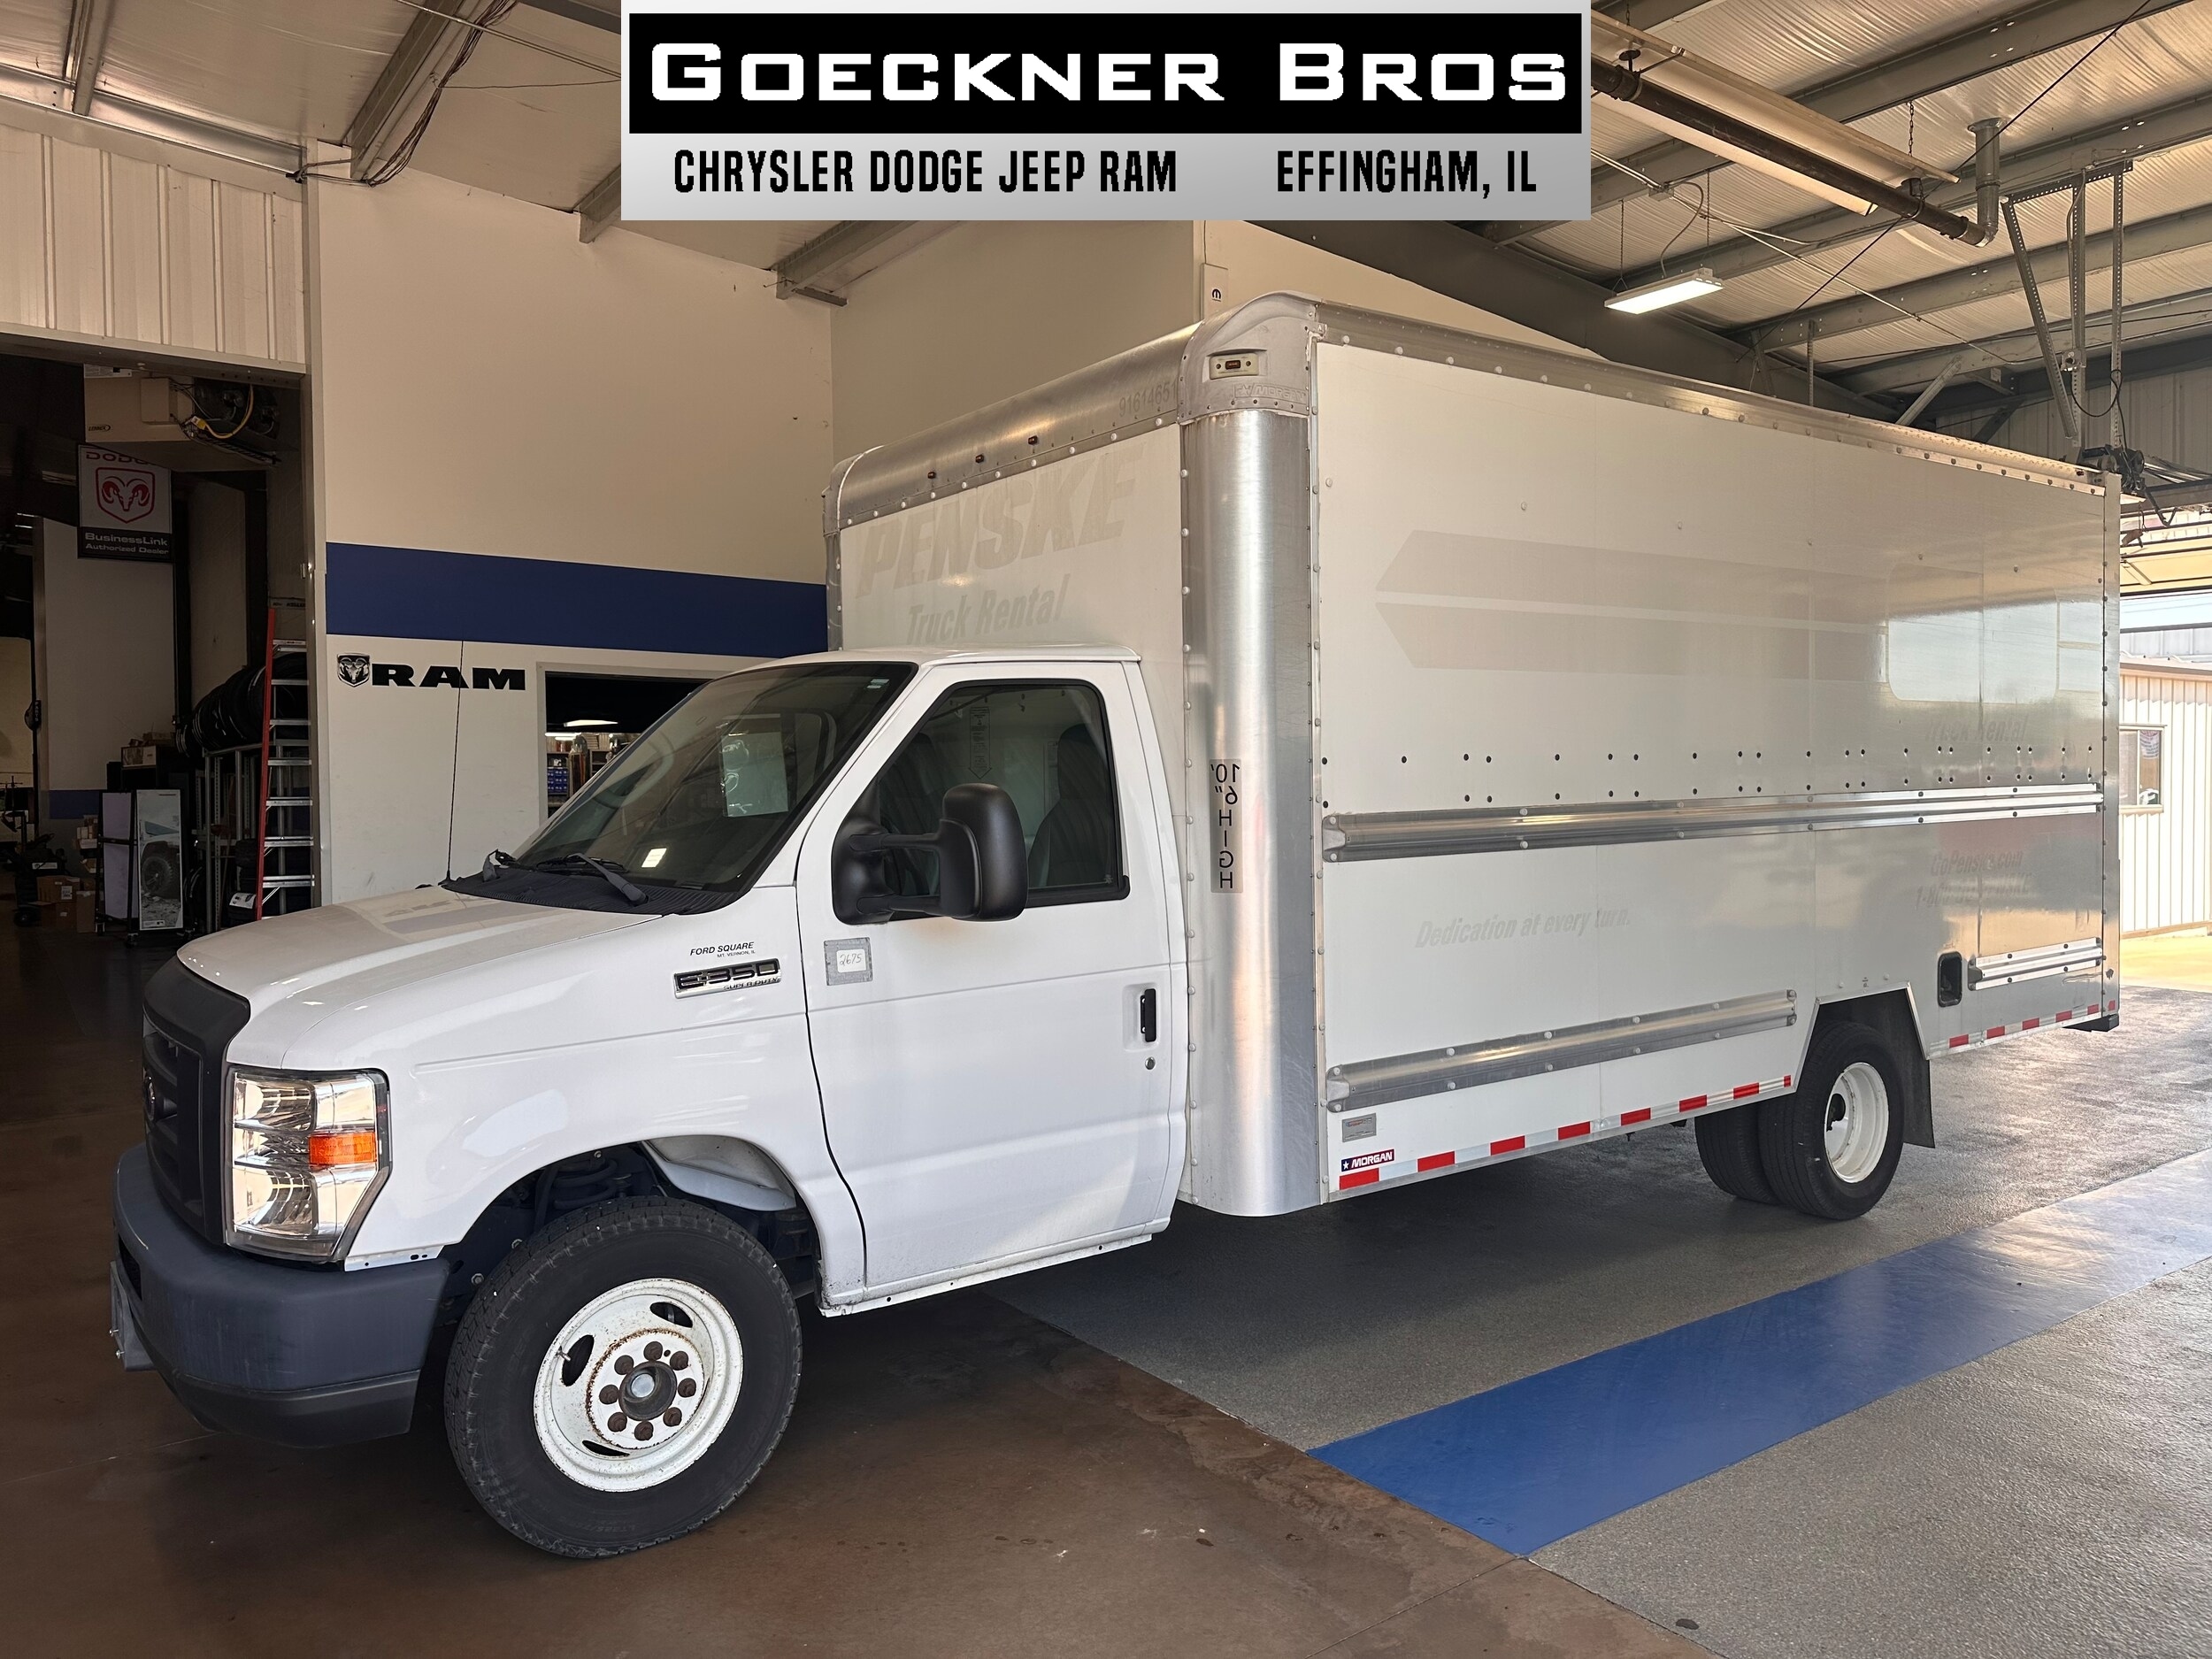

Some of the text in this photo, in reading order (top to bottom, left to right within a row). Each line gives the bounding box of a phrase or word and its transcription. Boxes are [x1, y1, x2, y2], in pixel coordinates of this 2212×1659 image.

[856, 446, 1146, 598] PENSKE
[85, 532, 168, 546] BusinessLink
[85, 543, 136, 553] Authorized
[907, 576, 1070, 645] Truck Rental
[372, 663, 526, 691] RAM
[1416, 916, 1517, 948] Dedication
[1519, 913, 1542, 937] at
[1546, 911, 1592, 936] every
[690, 941, 755, 956] FORD SQUARE
[839, 953, 863, 966] 2675
[723, 978, 780, 992] SUPER DUTY
[1351, 1152, 1393, 1168] MORGAN
